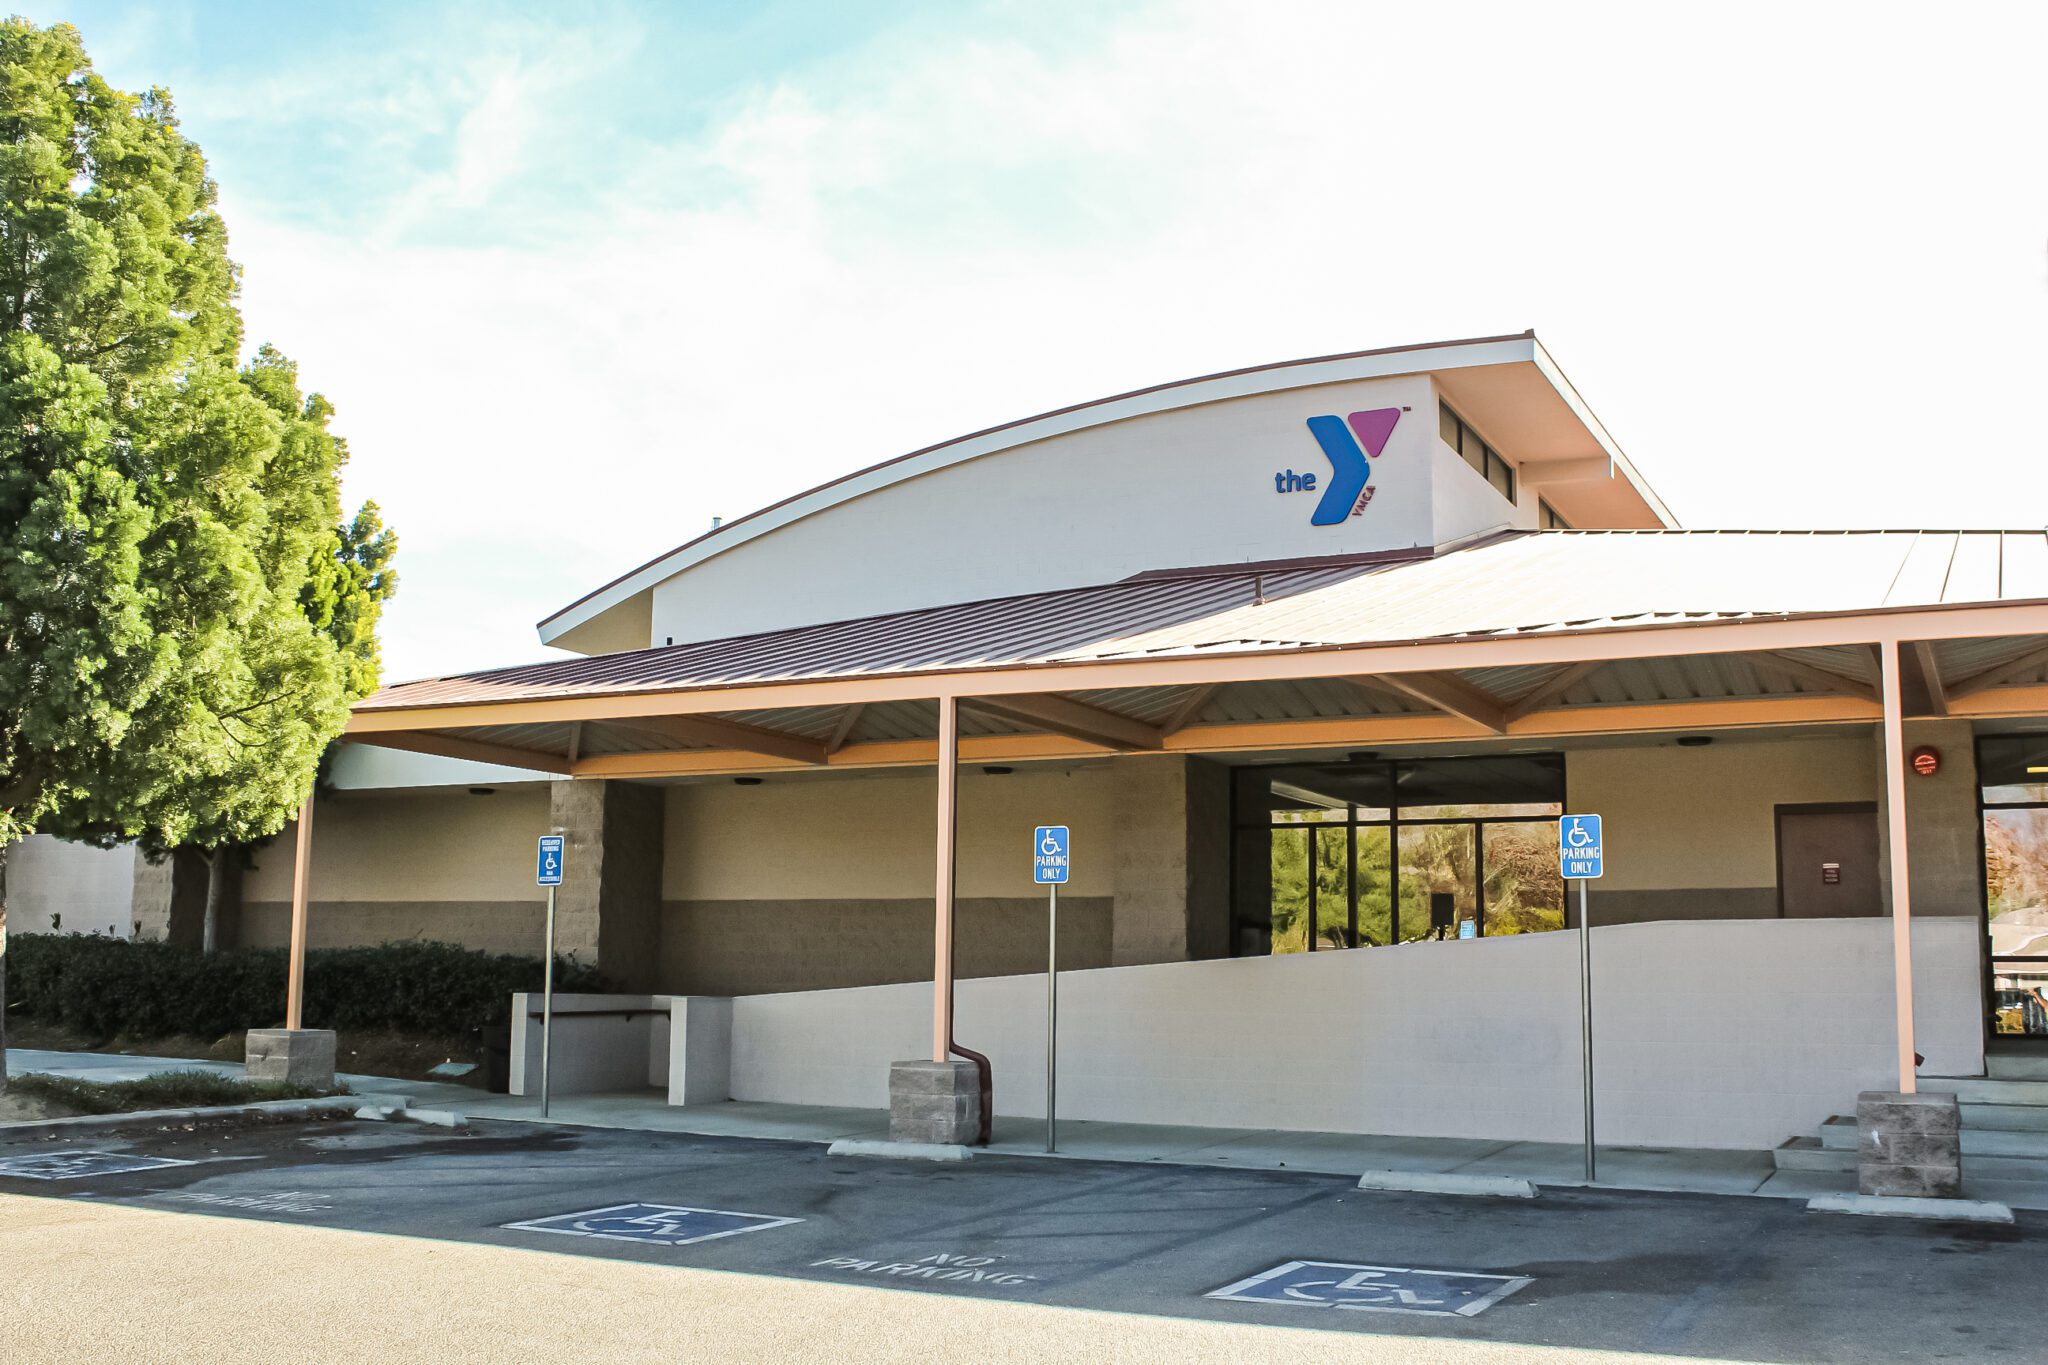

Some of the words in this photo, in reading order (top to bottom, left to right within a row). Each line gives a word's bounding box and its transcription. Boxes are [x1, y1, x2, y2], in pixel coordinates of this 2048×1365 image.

[1275, 469, 1317, 493] the
[1352, 485, 1376, 516] YMCA
[1563, 846, 1600, 860] PARKING
[1036, 855, 1067, 867] PARKING
[1571, 861, 1593, 874] ONLY
[1042, 868, 1060, 880] ONLY
[917, 1253, 997, 1267] NO
[809, 1256, 1040, 1286] PARKING
